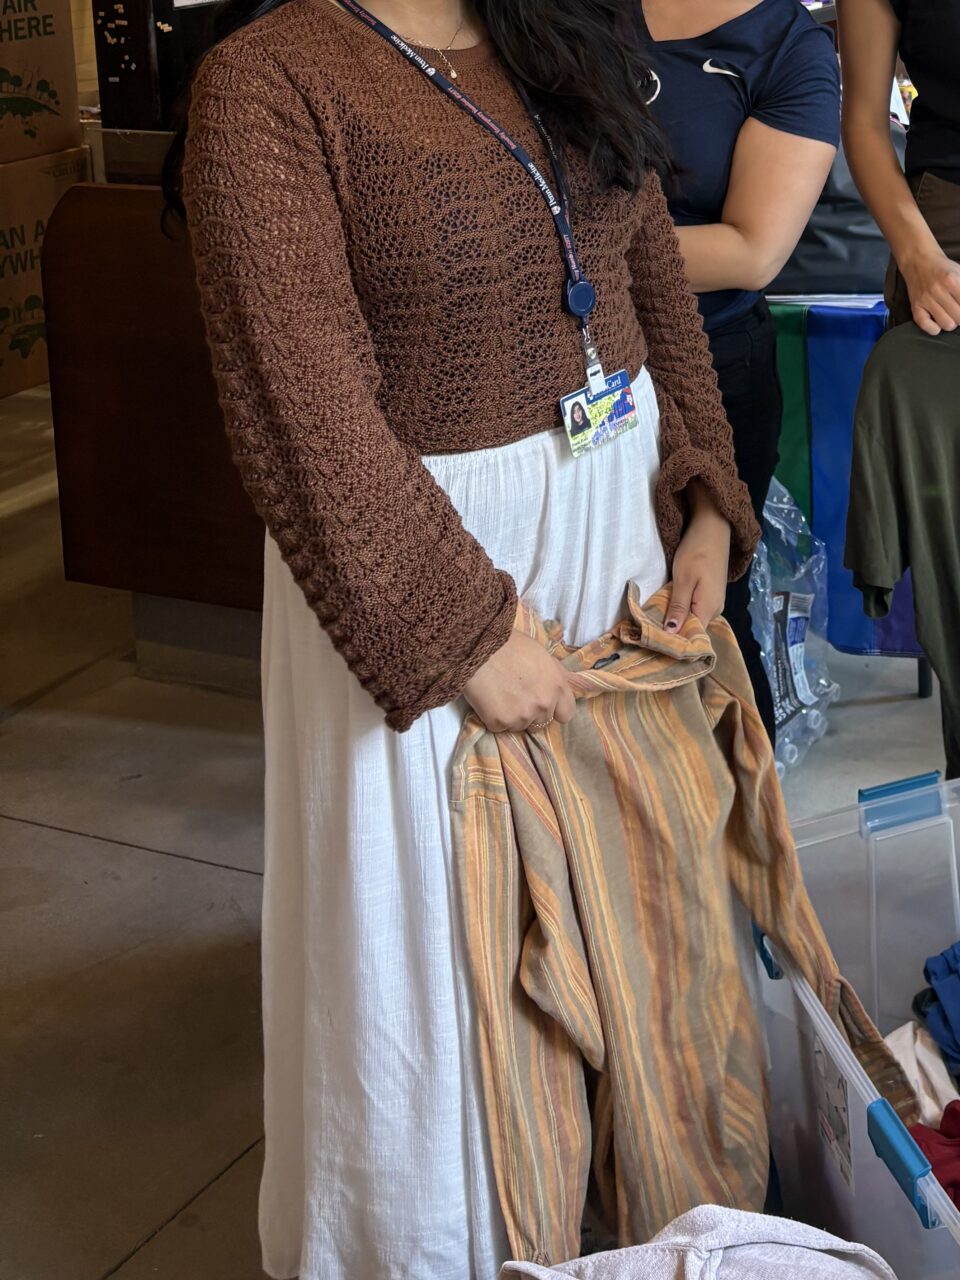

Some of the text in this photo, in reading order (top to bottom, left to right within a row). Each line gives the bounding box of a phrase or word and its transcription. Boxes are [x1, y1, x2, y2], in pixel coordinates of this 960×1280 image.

[0, 13, 55, 43] HERE
[390, 33, 429, 70] Penn Medicine
[527, 161, 548, 191] Medicine
[543, 189, 557, 206] Penn
